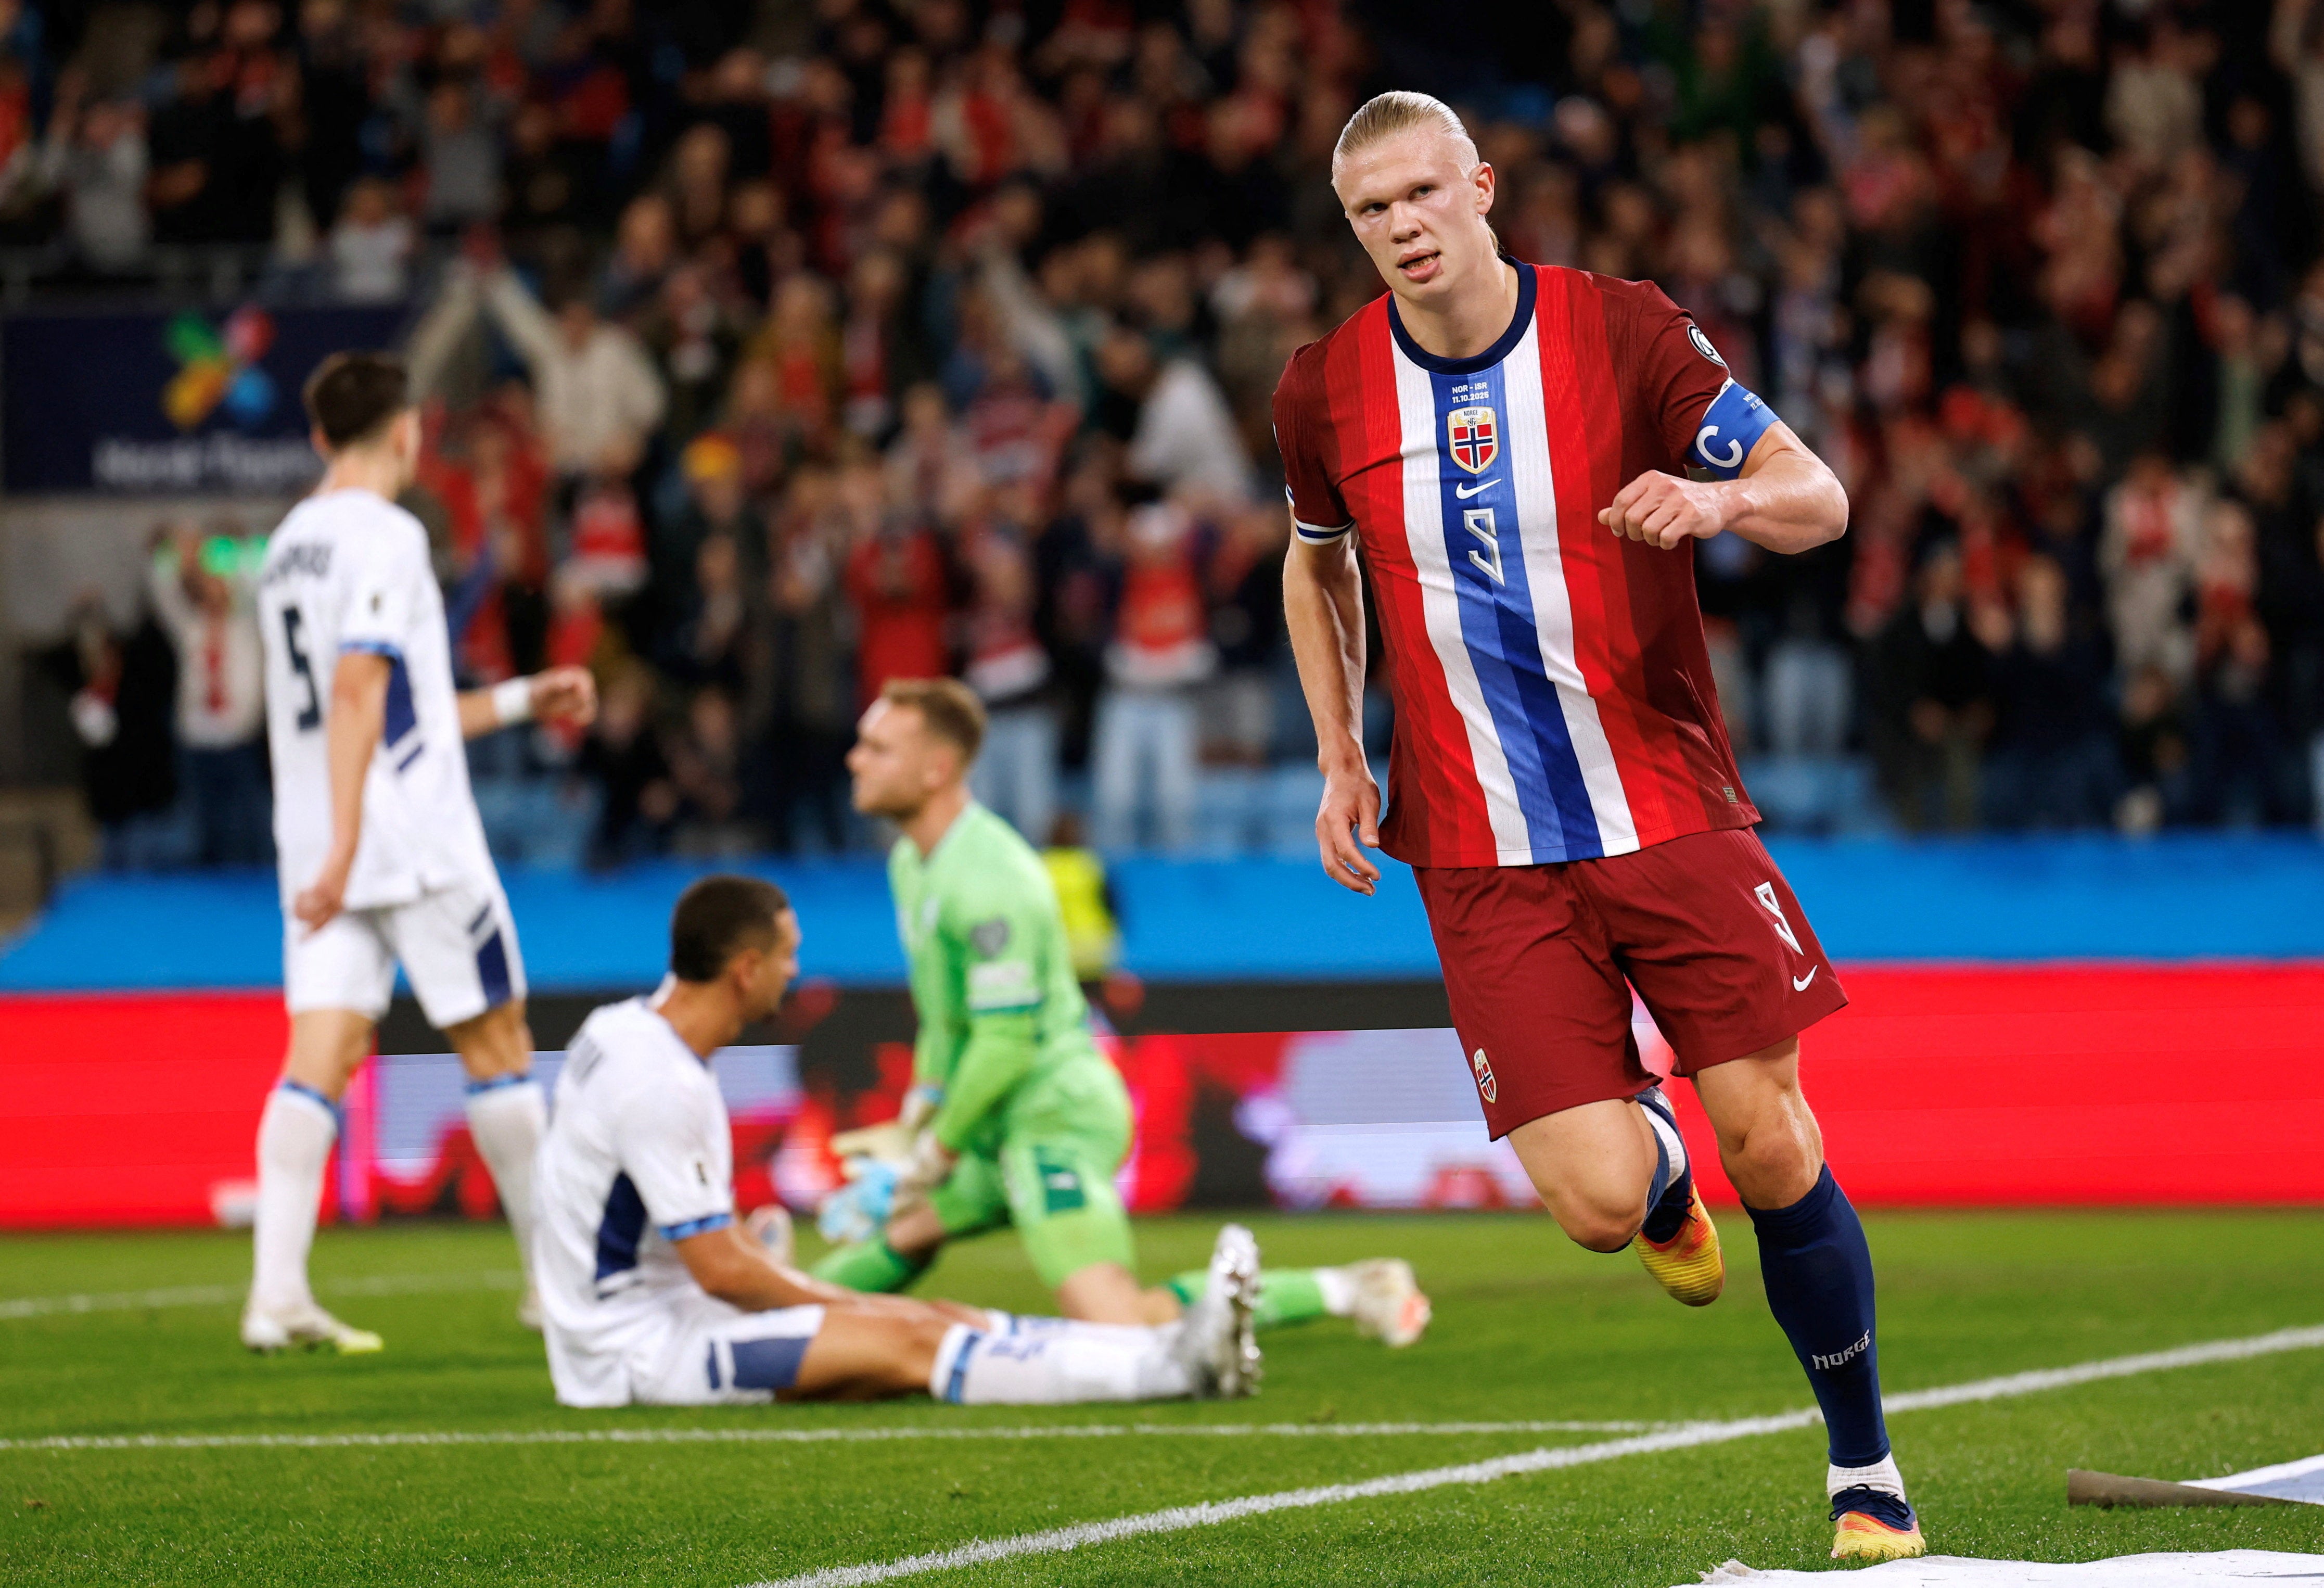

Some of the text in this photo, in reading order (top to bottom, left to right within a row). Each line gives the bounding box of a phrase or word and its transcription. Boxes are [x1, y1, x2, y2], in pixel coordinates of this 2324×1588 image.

[1452, 385, 1469, 394] NOR
[1474, 382, 1488, 390] ISR
[1452, 391, 1489, 403] 11.10.2025
[1696, 425, 1743, 468] C
[283, 604, 322, 730] 5
[1812, 1329, 1870, 1370] NORGE
